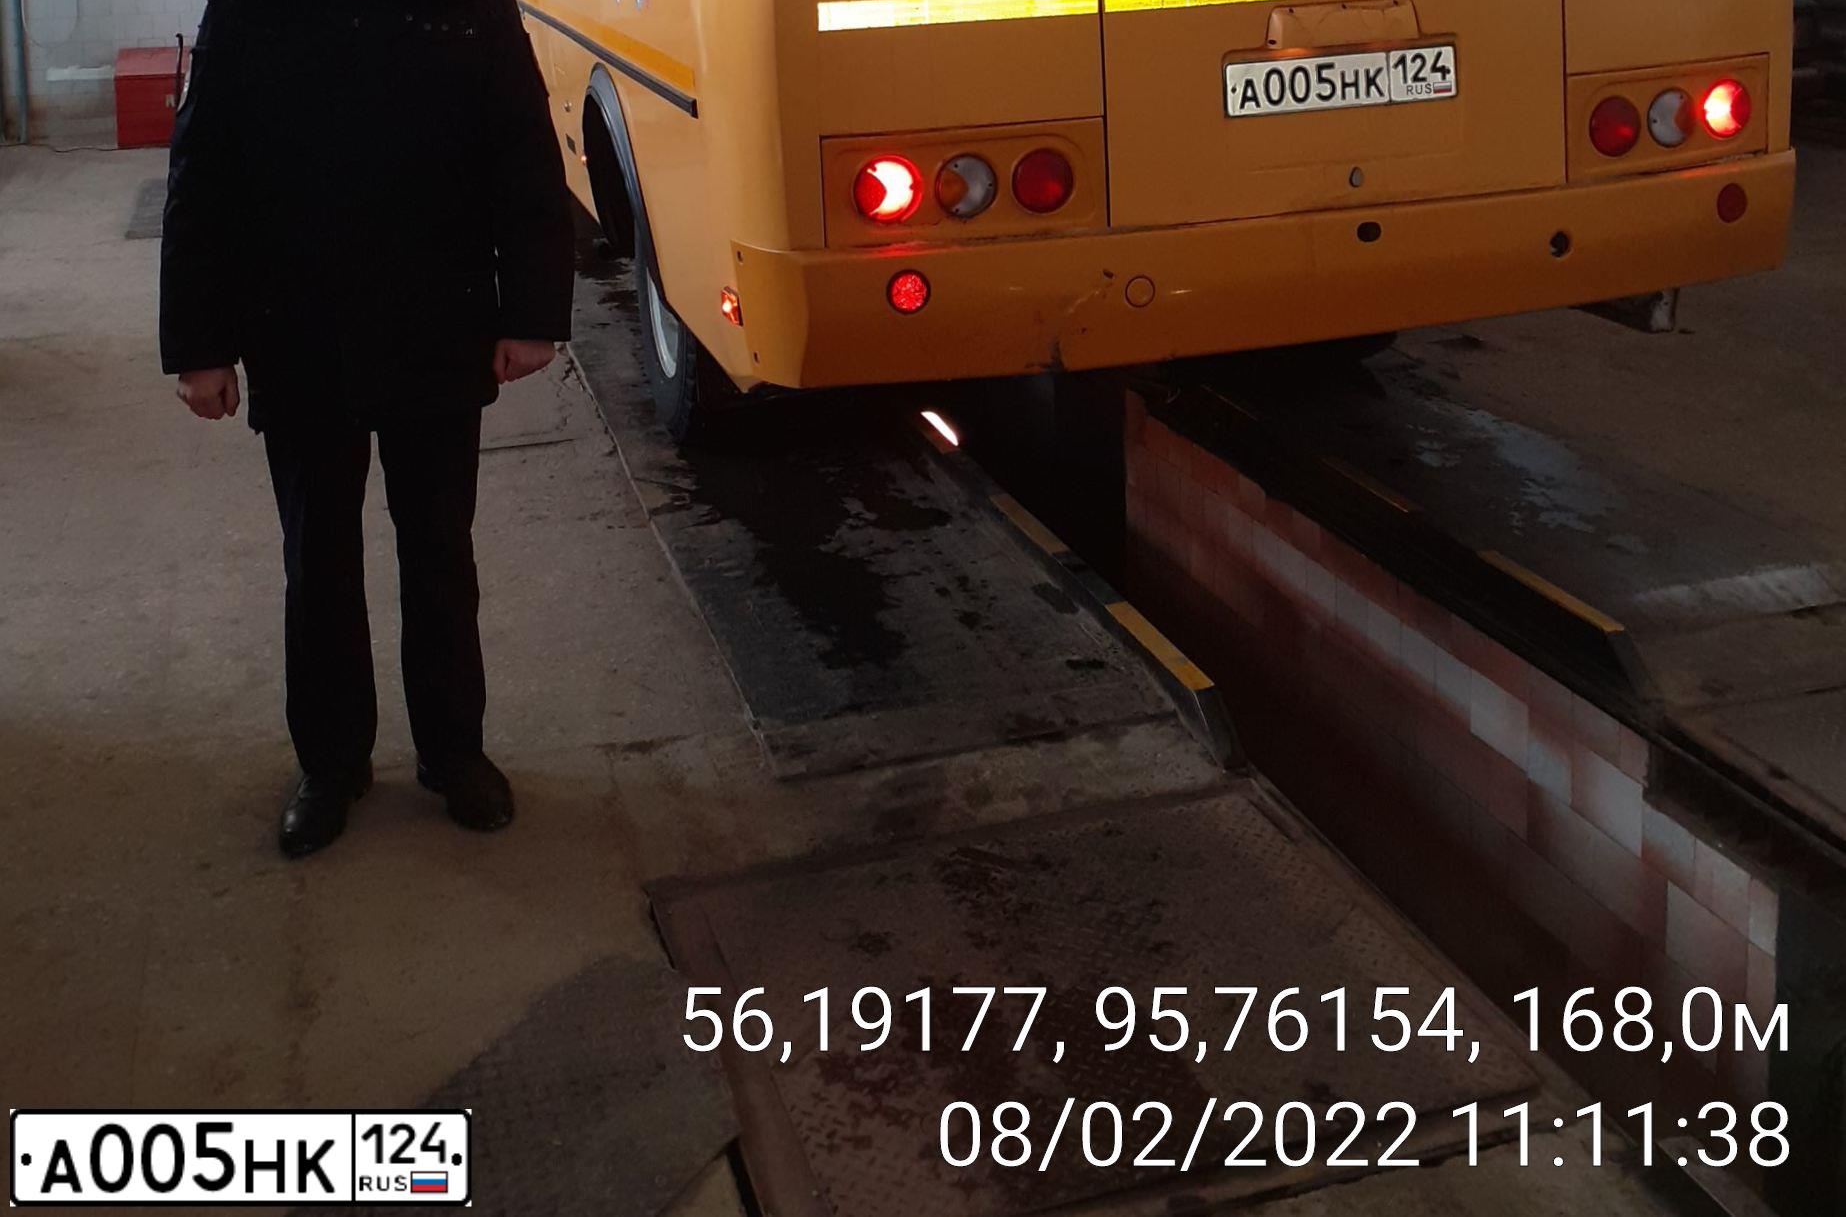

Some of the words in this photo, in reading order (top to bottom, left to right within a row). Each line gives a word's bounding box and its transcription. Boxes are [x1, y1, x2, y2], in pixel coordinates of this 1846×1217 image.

[1238, 62, 1386, 110] А005НК
[1392, 51, 1451, 84] 124
[1406, 83, 1432, 95] RUS
